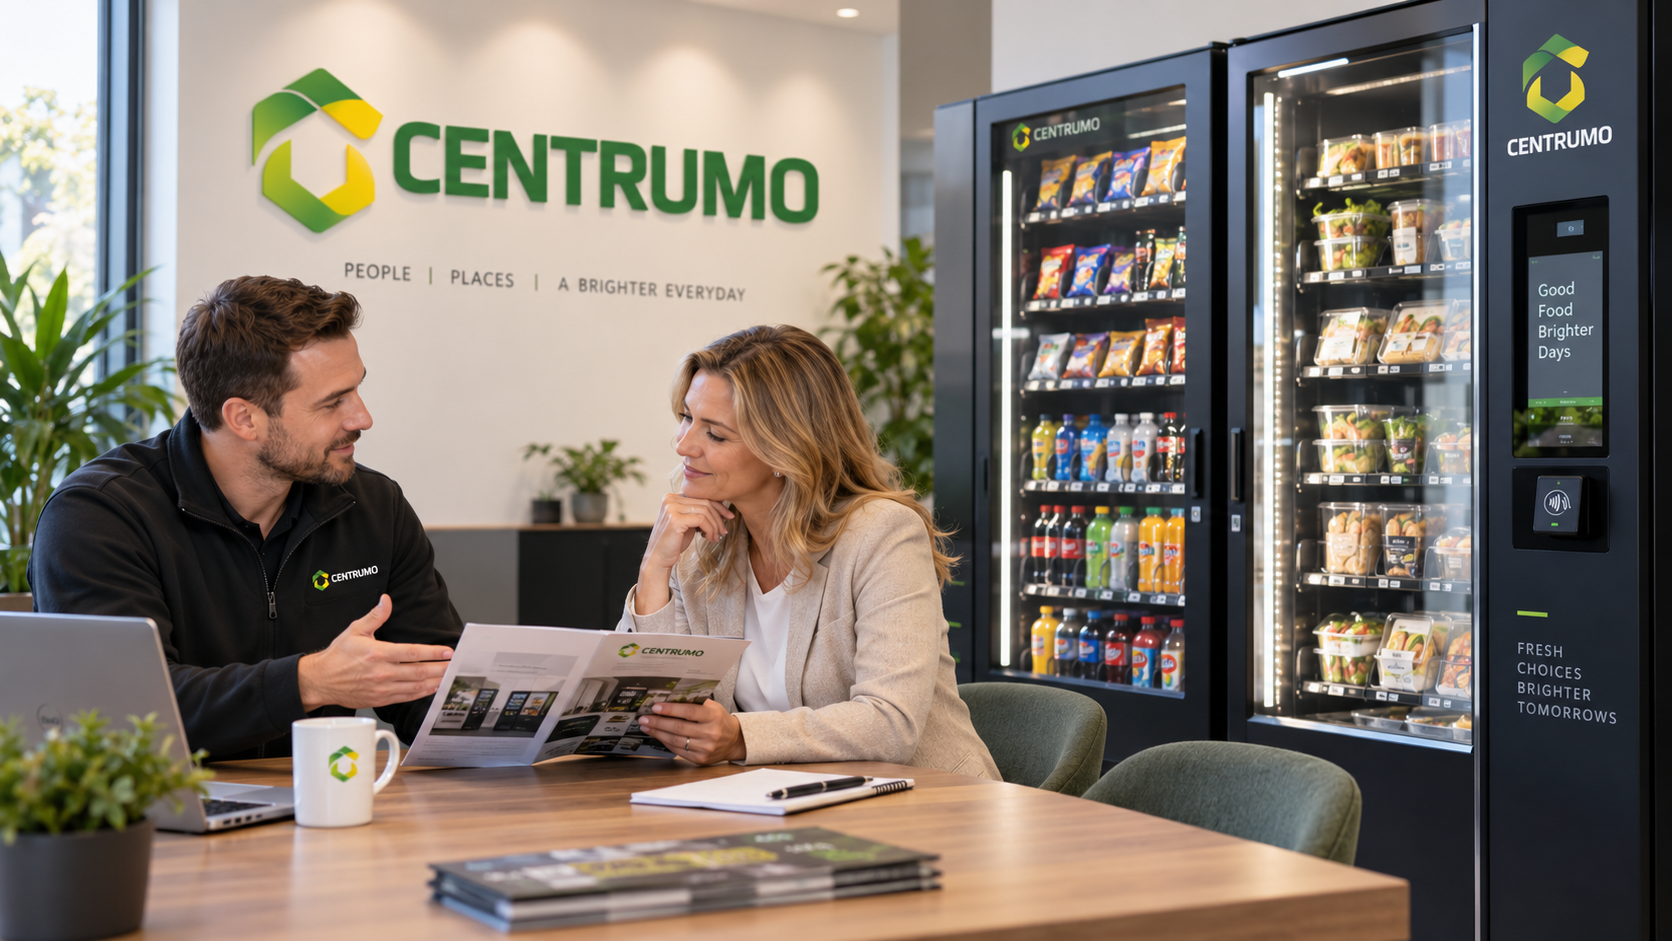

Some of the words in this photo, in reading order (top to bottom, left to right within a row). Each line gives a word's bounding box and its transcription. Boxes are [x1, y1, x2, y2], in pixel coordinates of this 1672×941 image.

[1033, 117, 1100, 141] CENTRUMO
[1507, 125, 1613, 157] CENTRUMO
[393, 121, 819, 224] CENTRUMO
[344, 262, 411, 282] PEOPLE
[450, 269, 514, 288] PLACES
[558, 277, 569, 291] A
[578, 279, 657, 297] BRIGHTER
[665, 283, 746, 302] EVERYDAY
[1538, 281, 1575, 297] Good
[1538, 302, 1573, 318] Food
[1538, 323, 1594, 341] Brighter
[1538, 345, 1571, 362] Days
[331, 565, 379, 583] CENTRUMO
[641, 647, 704, 657] CENTRUMO
[1517, 642, 1563, 658] FRESH
[1517, 662, 1582, 680] CHOICES
[1517, 681, 1591, 702] BRIGHTER
[1517, 701, 1617, 724] TOMORROWS
